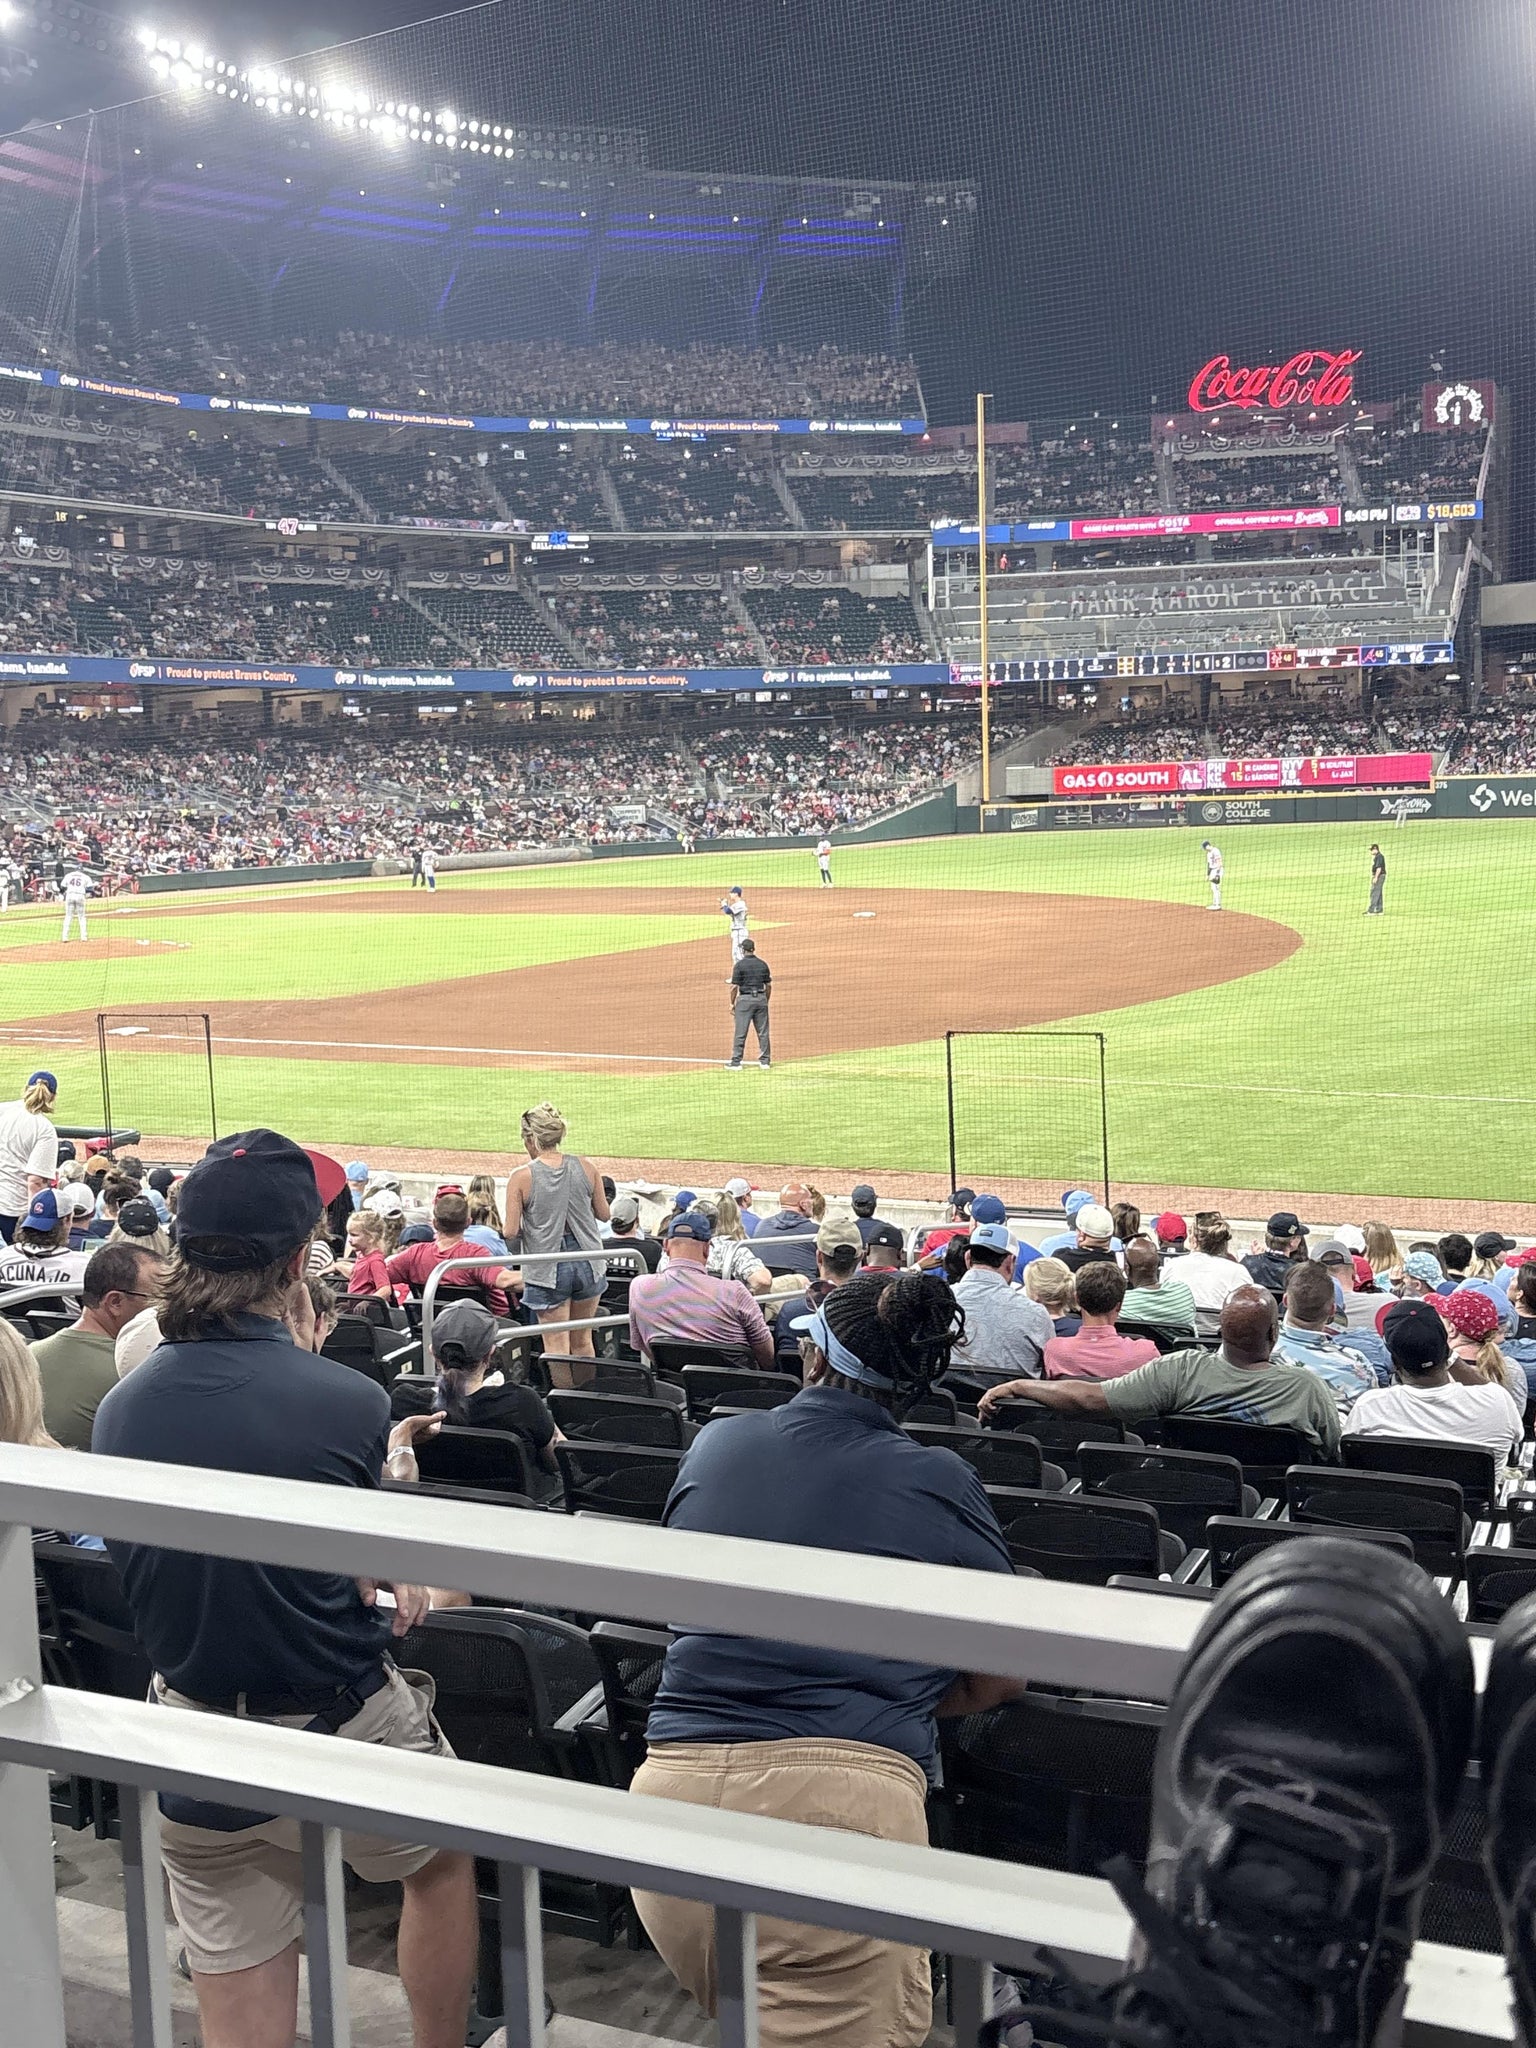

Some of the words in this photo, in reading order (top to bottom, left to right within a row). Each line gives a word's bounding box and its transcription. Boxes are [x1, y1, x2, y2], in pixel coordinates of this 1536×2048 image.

[1188, 350, 1362, 412] Coca-Cola
[1427, 504, 1476, 519] $18,603
[277, 518, 299, 535] 47
[1158, 517, 1191, 527] COSTA
[1070, 588, 1136, 613] HANK
[1150, 582, 1239, 611] AARON
[1250, 576, 1380, 605] TERRACE
[166, 667, 192, 678] Proud
[193, 668, 203, 679] to
[204, 669, 234, 681] protect
[234, 669, 262, 680] Braves
[263, 670, 297, 683] Country.
[547, 676, 572, 686] Proud
[573, 677, 583, 686] to
[583, 677, 616, 687] protect
[648, 675, 688, 686] Country.
[1207, 762, 1226, 773] PHI
[1311, 759, 1318, 769] 5
[1063, 774, 1096, 788] GAS
[1116, 771, 1169, 786] SOUTH
[1180, 769, 1203, 784] AL
[1230, 771, 1243, 781] 15
[1225, 801, 1261, 810] SOUTH
[1225, 809, 1271, 818] COLLEGE
[69, 878, 81, 887] 46
